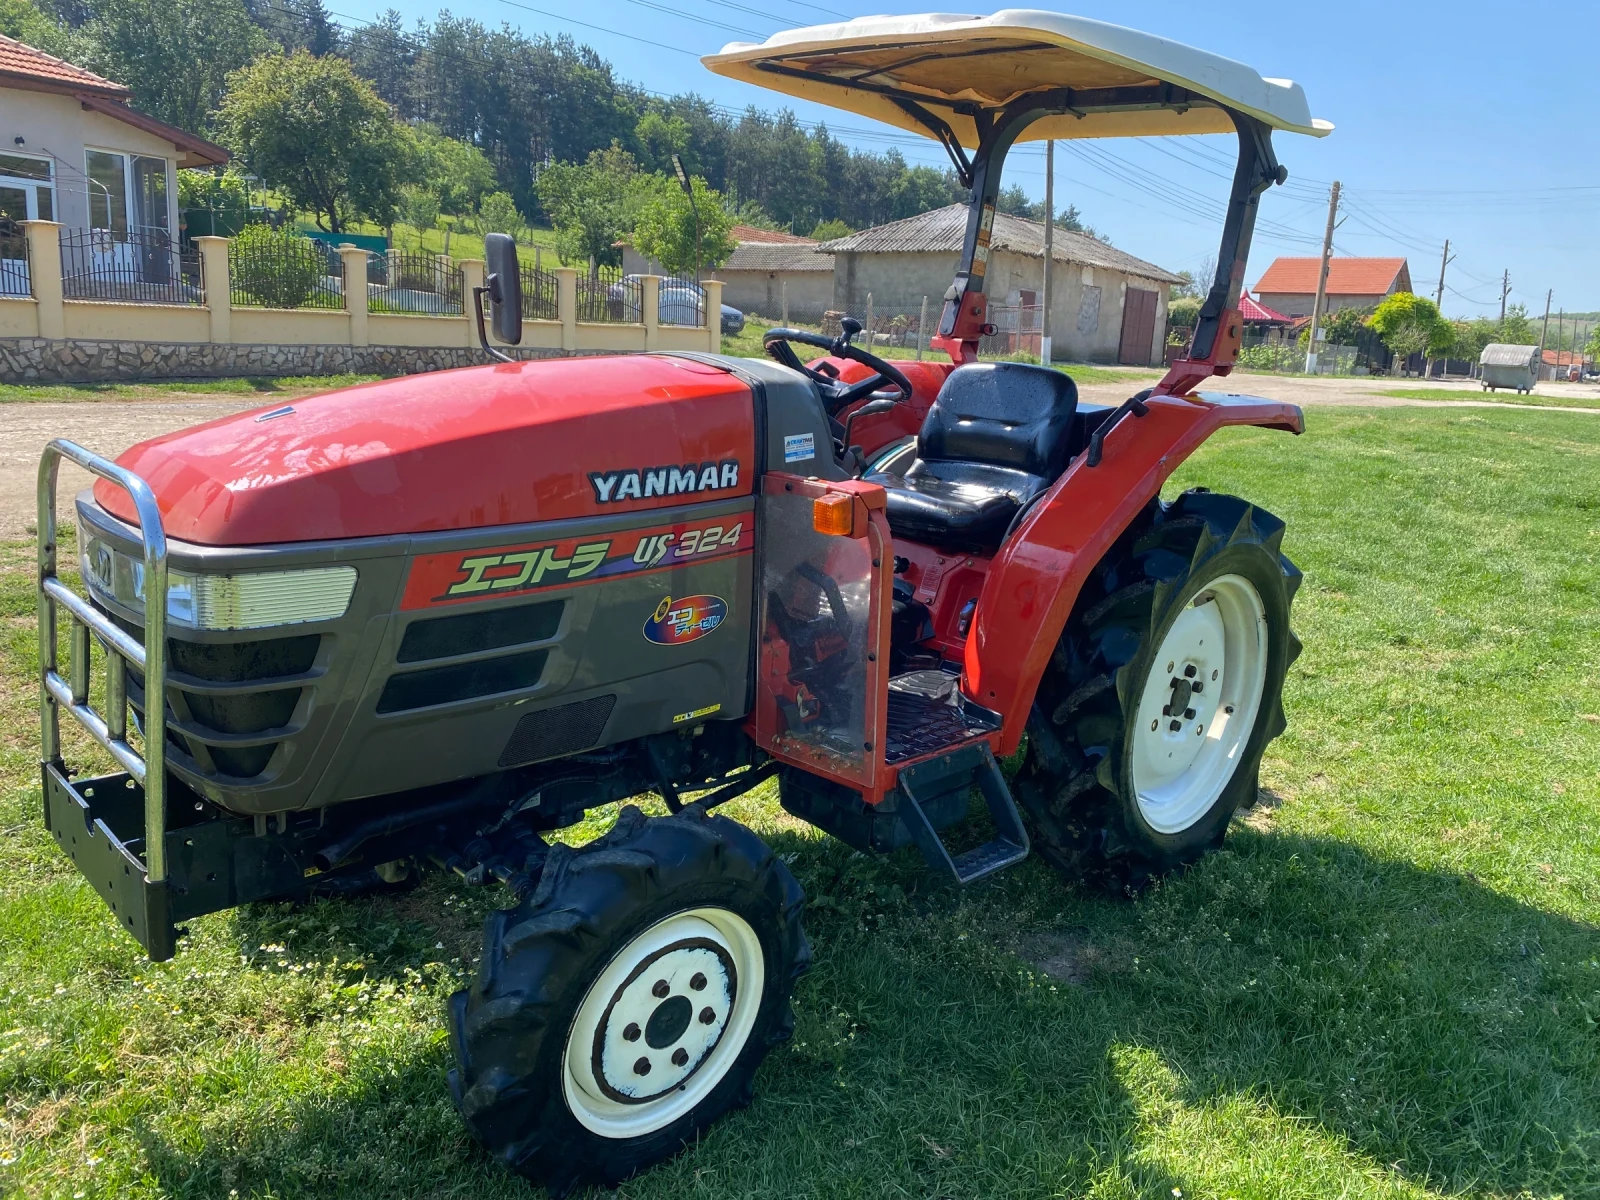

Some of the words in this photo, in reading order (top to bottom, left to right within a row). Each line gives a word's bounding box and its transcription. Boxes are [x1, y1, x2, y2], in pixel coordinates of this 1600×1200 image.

[590, 461, 738, 502] YANMAR
[448, 542, 609, 595] エコトラ
[667, 606, 694, 625] エコ
